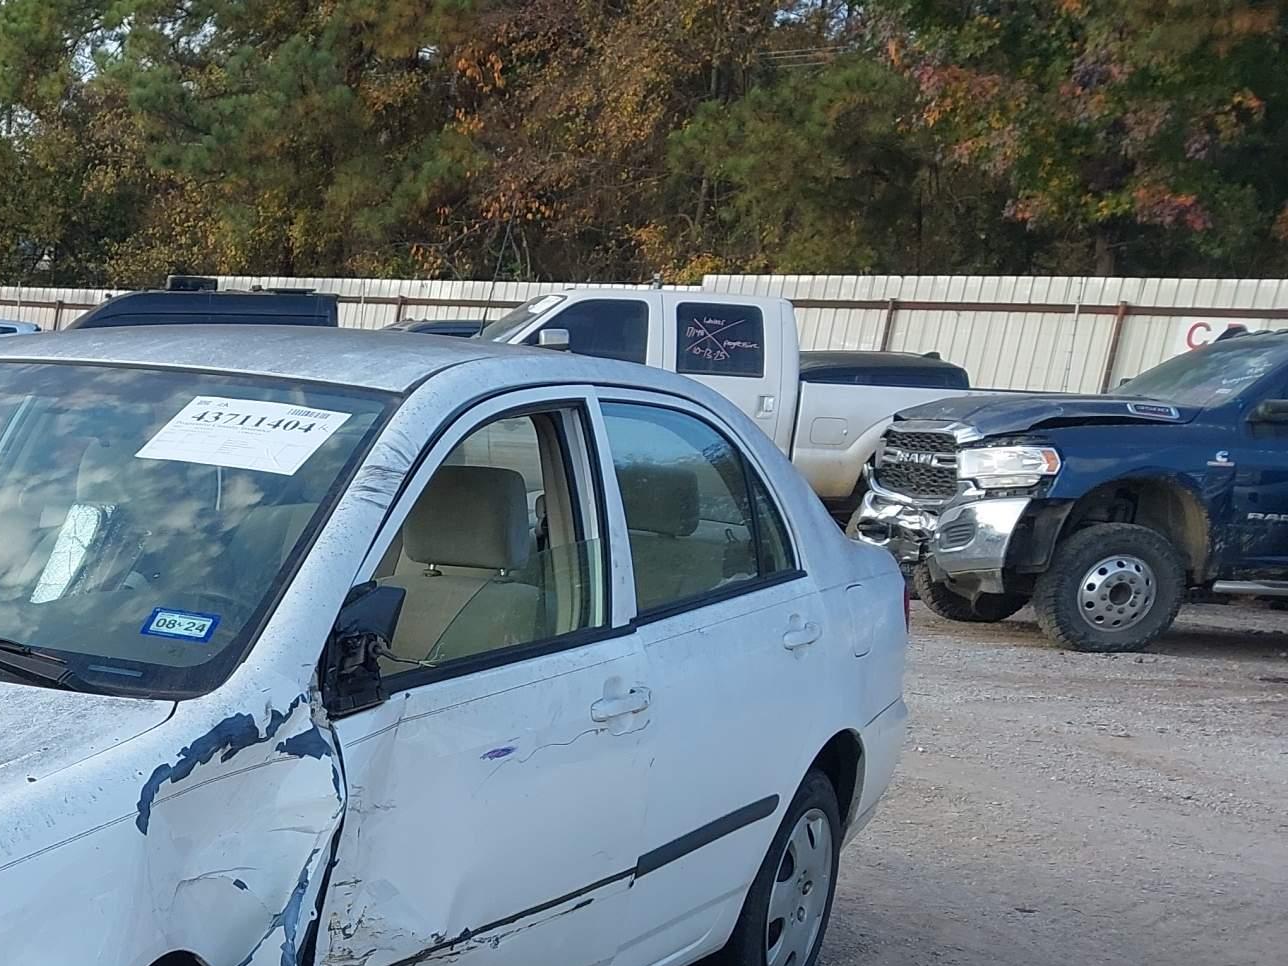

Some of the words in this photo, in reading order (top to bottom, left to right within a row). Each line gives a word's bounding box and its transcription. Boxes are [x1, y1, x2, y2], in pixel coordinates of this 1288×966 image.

[1186, 321, 1212, 350] C
[191, 410, 317, 434] 43711404
[896, 450, 933, 465] RAM
